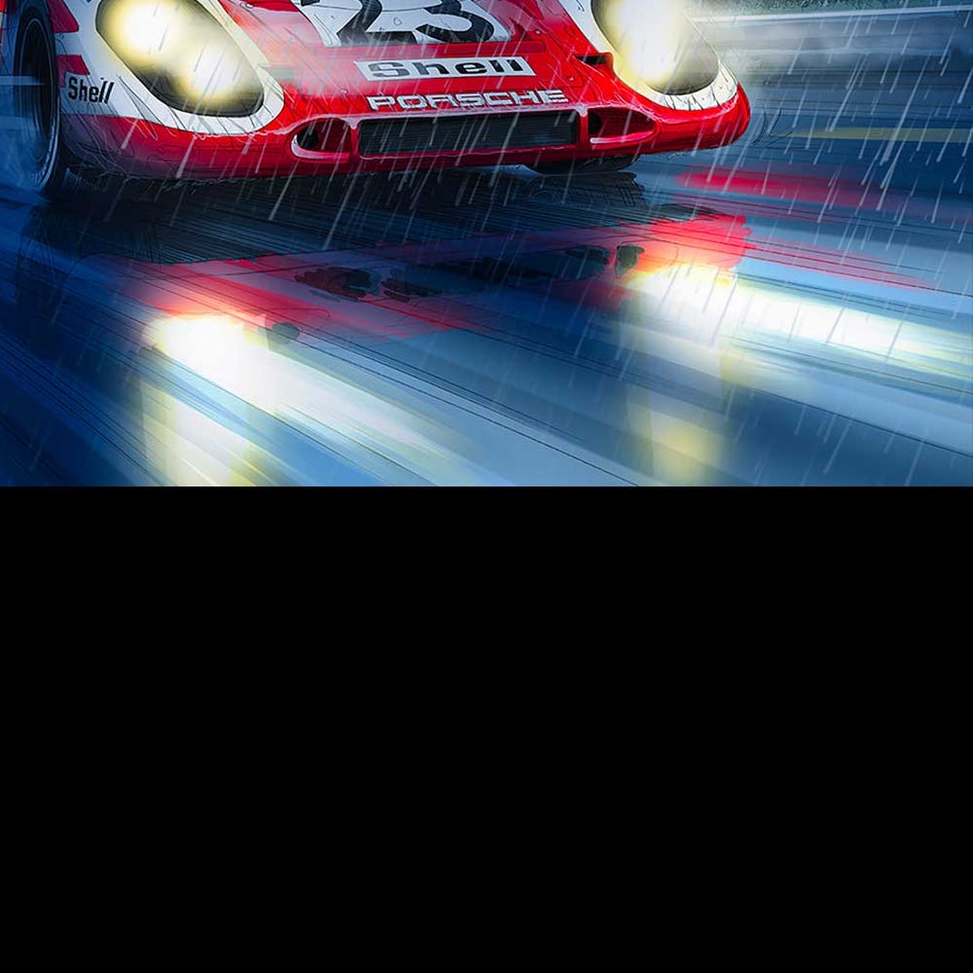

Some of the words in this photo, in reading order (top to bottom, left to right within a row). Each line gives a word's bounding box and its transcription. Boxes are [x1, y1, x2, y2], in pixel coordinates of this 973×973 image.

[367, 58, 525, 78] Shell
[68, 76, 115, 105] Shell
[366, 88, 570, 111] PORSCHE
